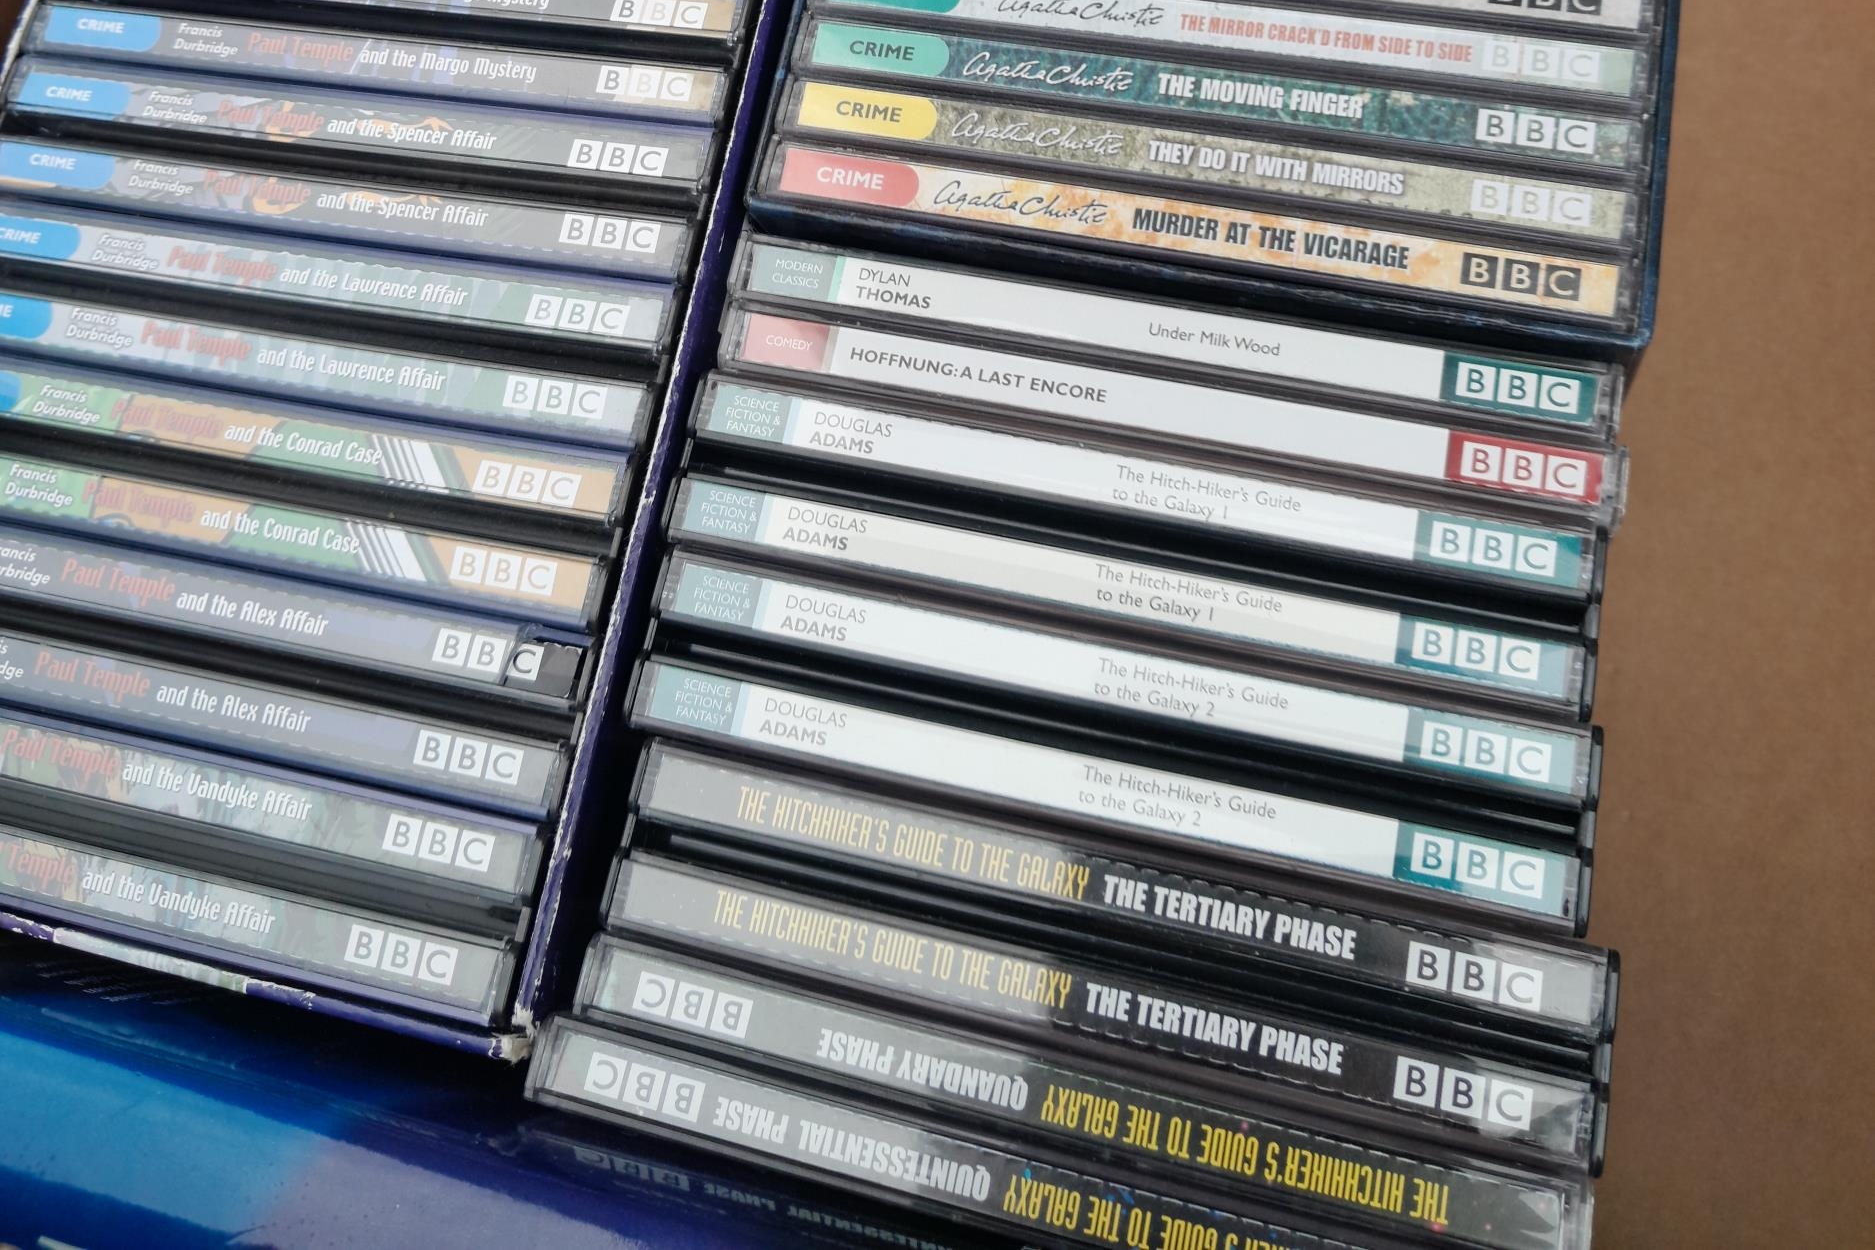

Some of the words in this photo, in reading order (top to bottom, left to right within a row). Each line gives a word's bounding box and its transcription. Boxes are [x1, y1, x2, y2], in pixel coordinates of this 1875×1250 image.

[849, 40, 915, 61] CRIME
[1158, 73, 1195, 98] THE
[1200, 77, 1284, 110] MOVING
[1289, 90, 1364, 118] FINGER
[1480, 111, 1594, 151] BBC
[835, 100, 903, 123] CRIME
[1148, 140, 1194, 165] THEY
[1199, 145, 1227, 170] DO
[1230, 149, 1250, 173] IT
[1255, 153, 1307, 181] WITH
[1312, 162, 1404, 195] MIRRORS
[377, 196, 439, 221] Spencer
[442, 205, 489, 227] Affair
[561, 215, 660, 252] BBC
[816, 166, 884, 190] CRIME
[1132, 207, 1218, 240] MURDER
[1224, 216, 1254, 243] AT
[1258, 225, 1295, 252] THE
[1303, 231, 1409, 270] VICARAGE
[1464, 255, 1579, 298] BBC
[855, 285, 931, 310] THOMAS
[859, 267, 911, 288] DYLAN
[765, 334, 813, 351] COMEDY
[1148, 322, 1195, 343] Under
[1200, 329, 1231, 349] Milk
[1234, 334, 1281, 357] Wood
[1458, 363, 1579, 412] BBC
[809, 430, 874, 455] ADAMS
[813, 410, 894, 438] DOUGLAS
[849, 346, 958, 379] HOFFNUNG:
[978, 367, 1024, 389] LAST
[1029, 377, 1107, 403] ENCORE
[1463, 442, 1586, 495] BBC
[225, 424, 253, 443] and
[257, 427, 283, 447] the
[286, 432, 342, 459] Conrad
[344, 441, 382, 464] Case
[474, 461, 580, 506] BBC
[1116, 464, 1145, 484] The
[1149, 470, 1250, 503] Hitch-Hiker's
[1256, 488, 1302, 512] Guide
[1112, 485, 1129, 502] to
[1134, 489, 1160, 507] the
[1164, 494, 1217, 522] Galaxy
[156, 685, 189, 706] and
[191, 688, 215, 713] the
[220, 695, 258, 721] Alex
[261, 703, 311, 733] Affair
[414, 731, 523, 784] BBC
[187, 773, 259, 810] Vandyke
[262, 789, 312, 822] Affair
[383, 815, 495, 871] BBC
[737, 785, 767, 824] THE
[772, 796, 891, 852] HITCHHIKER'S
[893, 822, 947, 868] GUIDE
[952, 836, 976, 873] TO
[979, 840, 1014, 882] THE
[1016, 852, 1090, 901] GALAXY
[1104, 874, 1149, 911] THE
[1154, 885, 1270, 939] TERTIARY
[1274, 916, 1357, 961] PHASE
[1408, 942, 1541, 1010] BBC
[586, 1053, 704, 1121] BBC
[713, 1095, 789, 1144] PHASE
[797, 1118, 991, 1202] QUINTESSENTIAL
